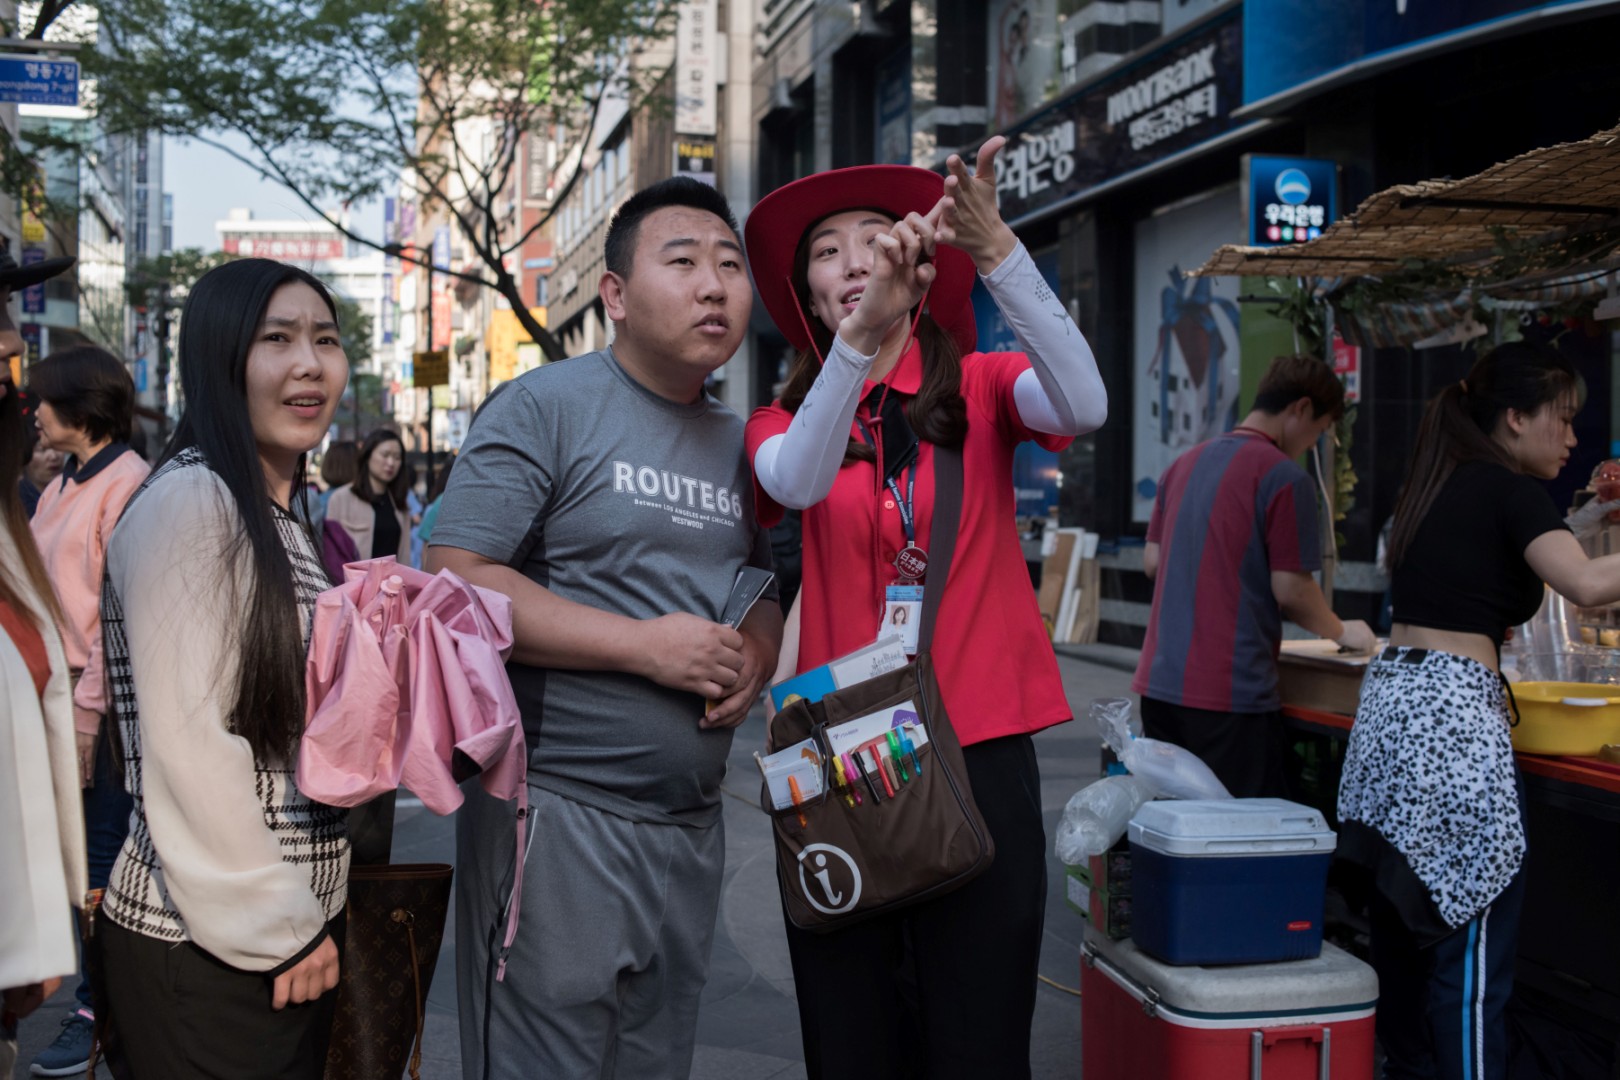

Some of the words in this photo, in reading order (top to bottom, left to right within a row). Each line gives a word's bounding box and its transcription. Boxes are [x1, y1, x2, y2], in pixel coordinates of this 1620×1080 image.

[25, 62, 76, 80] 명동7길
[678, 143, 715, 158] Nail
[1264, 203, 1325, 227] 우리은행
[613, 460, 743, 520] ROUTE66
[634, 498, 662, 509] Between
[663, 503, 674, 513] LOS
[674, 507, 699, 520] ANGELES
[699, 513, 710, 521] and
[711, 515, 735, 528] CHICAGO
[671, 515, 704, 530] WESTWOOD
[899, 551, 928, 573] 日本語
